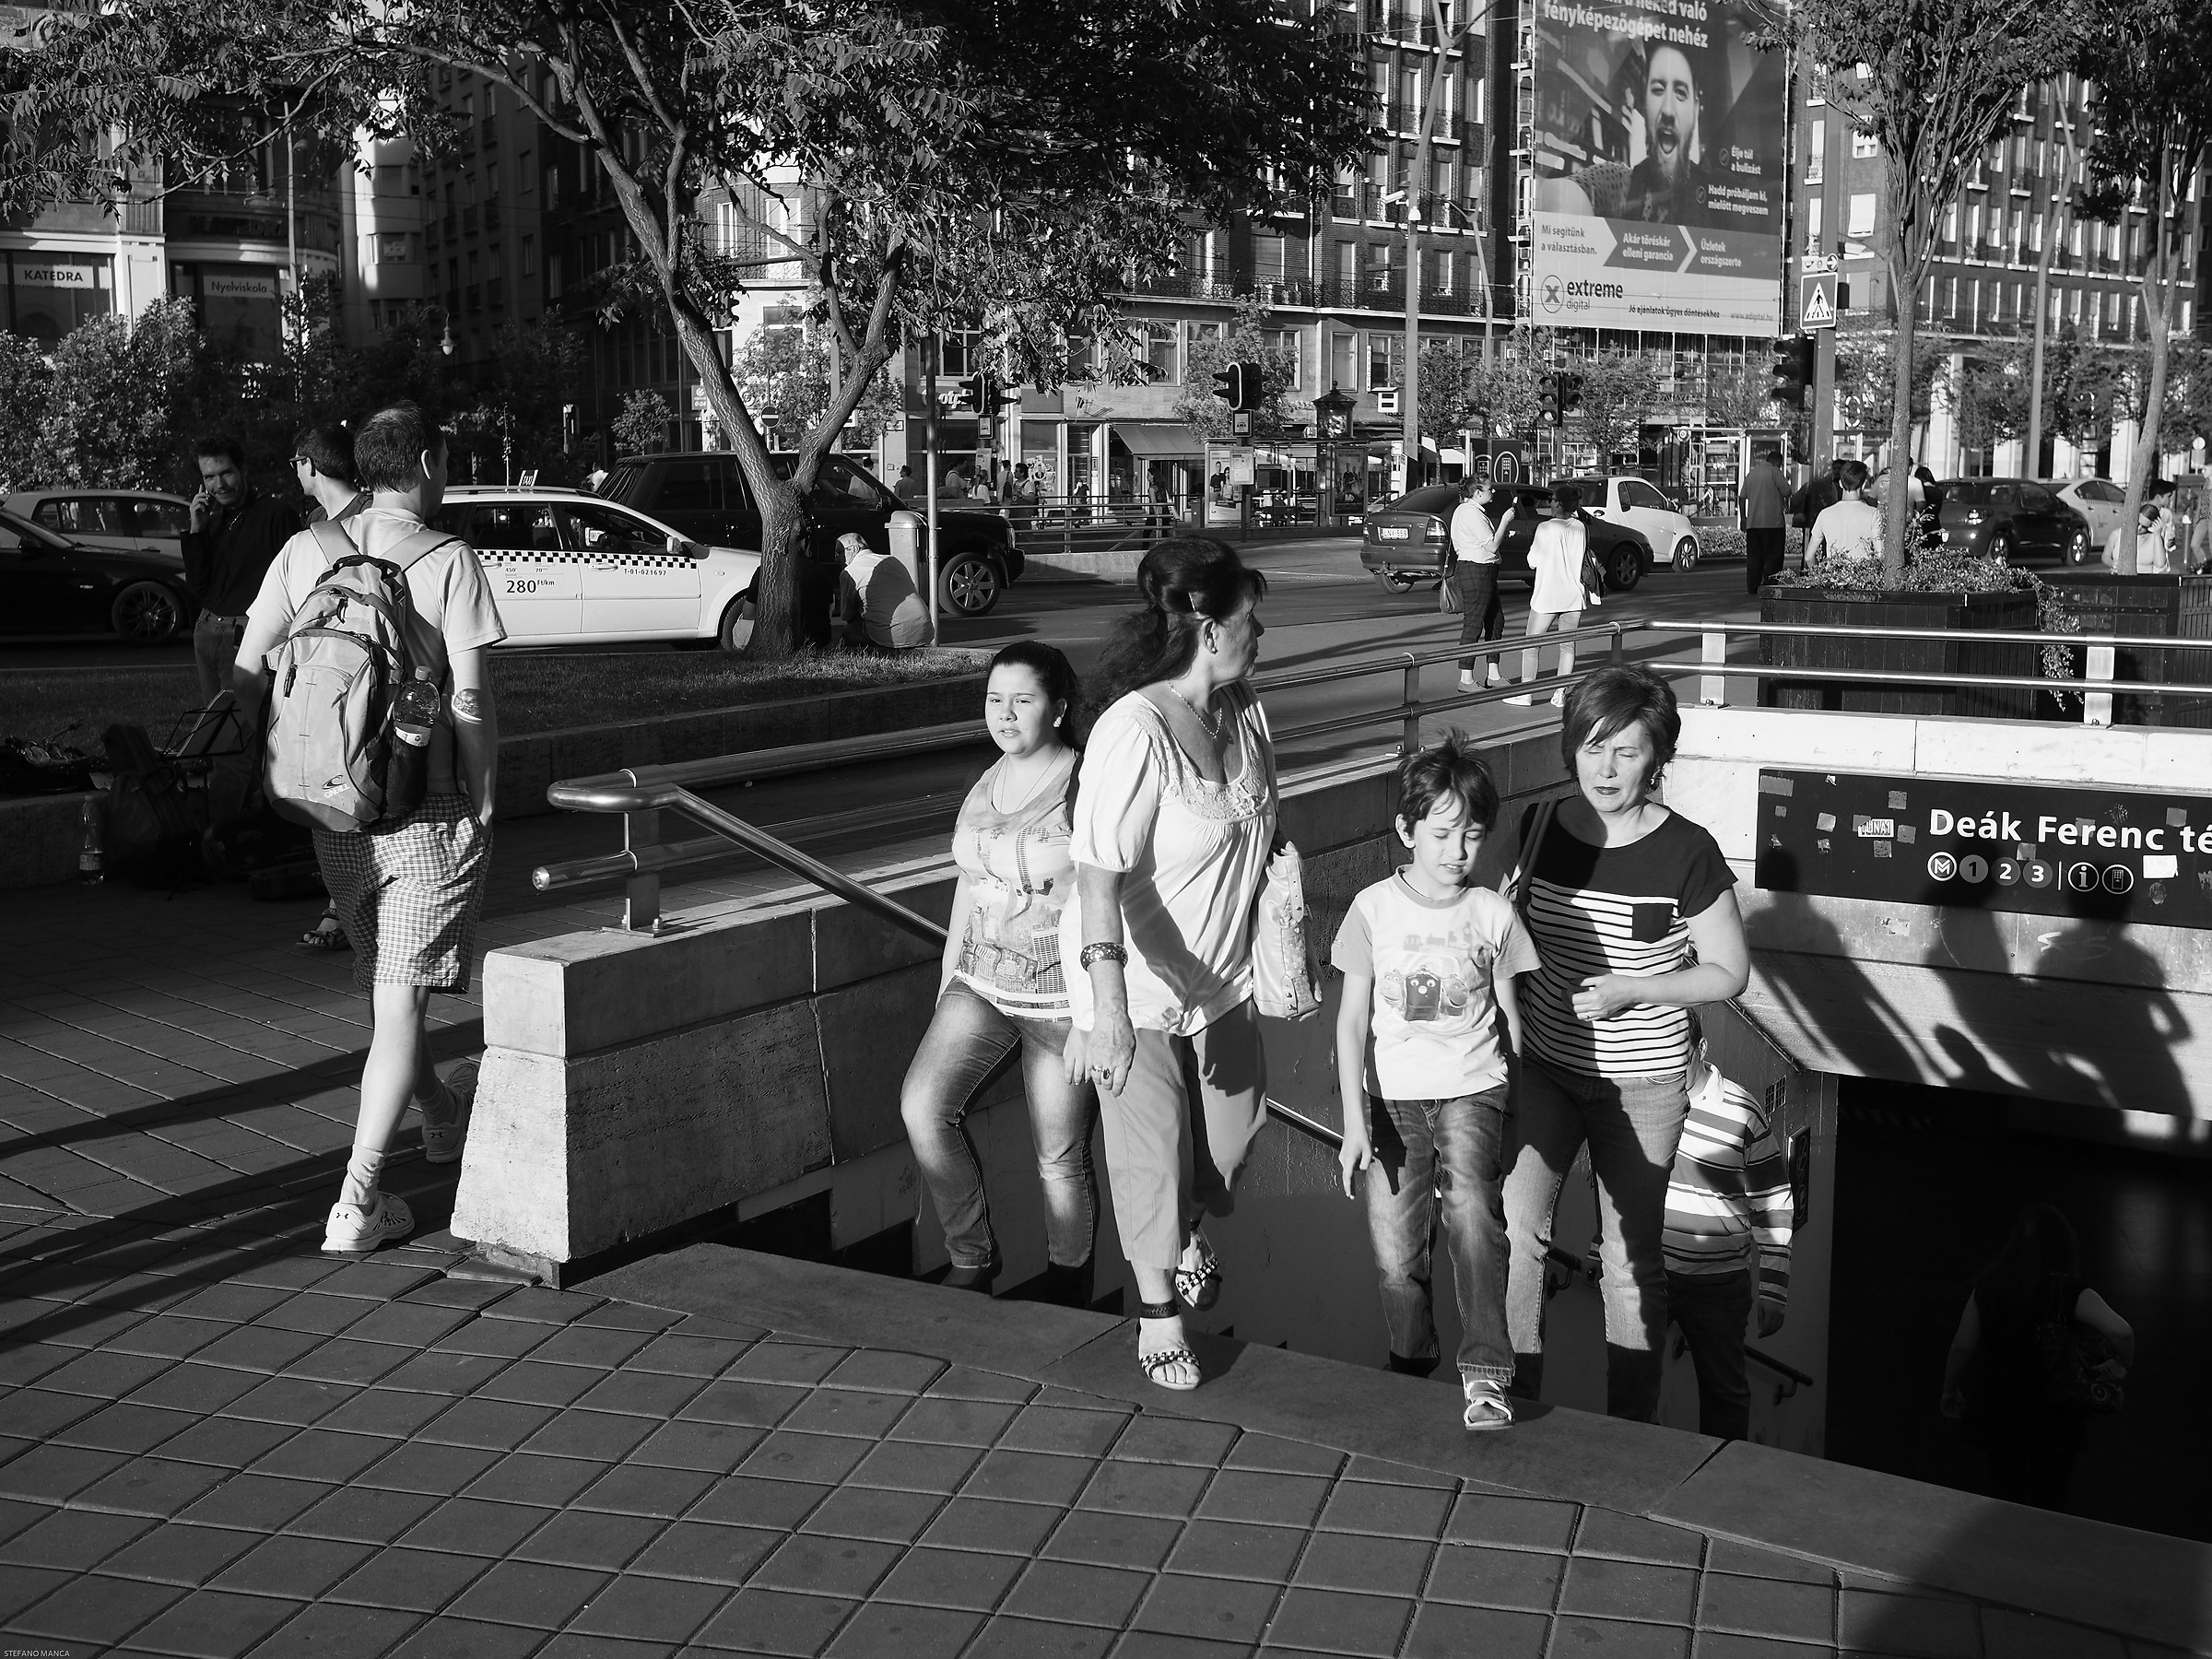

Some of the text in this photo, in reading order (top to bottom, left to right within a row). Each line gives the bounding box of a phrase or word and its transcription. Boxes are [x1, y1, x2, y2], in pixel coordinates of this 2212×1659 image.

[1677, 0, 1708, 21] való
[1544, 1, 1708, 48] fényképezőgépet nehéz
[1708, 184, 1726, 196] Hadd
[1541, 225, 1551, 234] Mi
[1623, 233, 1641, 244] Akár
[1623, 246, 1674, 262] elleni garancia
[1700, 255, 1742, 267] országszerte
[24, 270, 83, 282] KATEDRA
[211, 281, 267, 294] Nyelviskola
[1567, 279, 1623, 298] extreme
[1567, 300, 1591, 312] digital
[506, 580, 536, 594] 280
[1929, 808, 2022, 841] Deák
[2038, 815, 2165, 852] Ferenc
